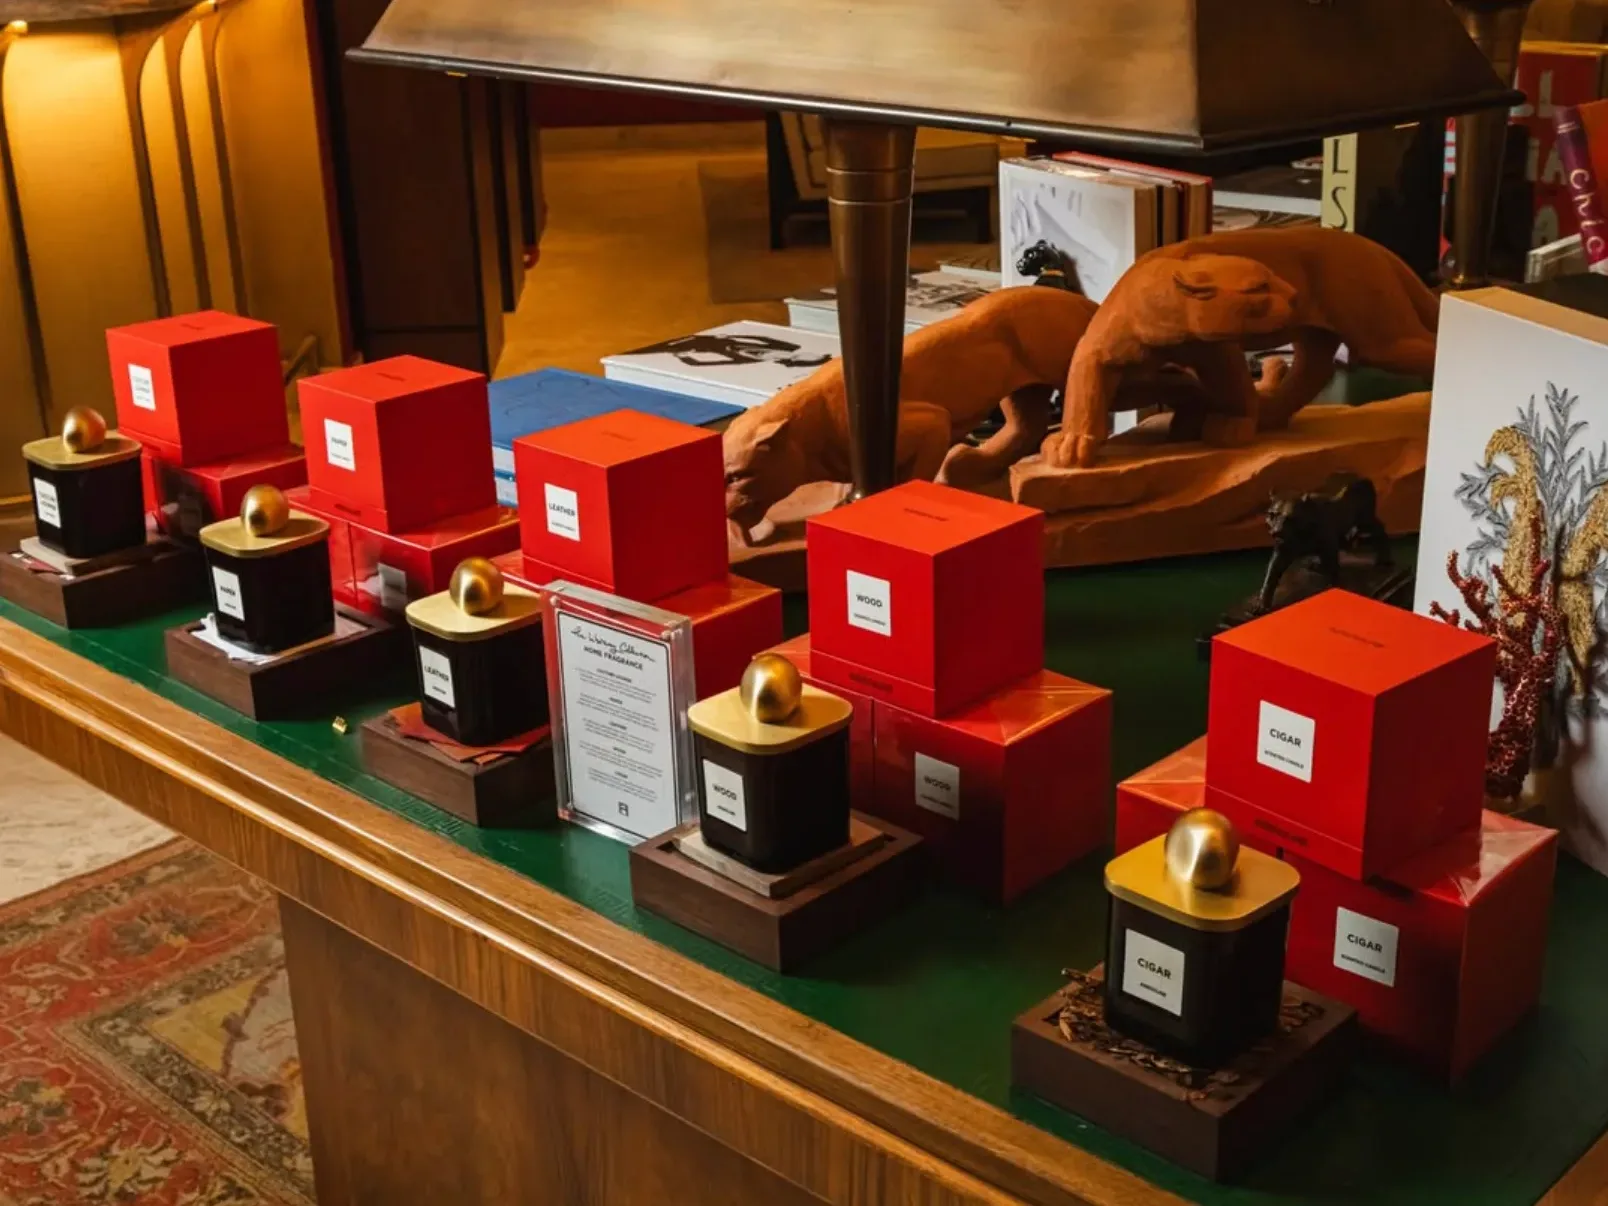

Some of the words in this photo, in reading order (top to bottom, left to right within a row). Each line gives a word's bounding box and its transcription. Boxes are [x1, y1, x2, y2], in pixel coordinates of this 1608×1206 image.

[548, 502, 576, 516] LEATHER
[856, 593, 883, 608] WOOD
[583, 645, 602, 658] HOME
[603, 652, 643, 671] FRAGRANCE
[424, 665, 449, 682] LEATHER
[1269, 728, 1302, 748] CIGAR
[712, 783, 737, 801] WOOD
[924, 775, 951, 791] WOOD
[1347, 934, 1383, 953] CIGAR
[1137, 957, 1171, 980] CIGAR
